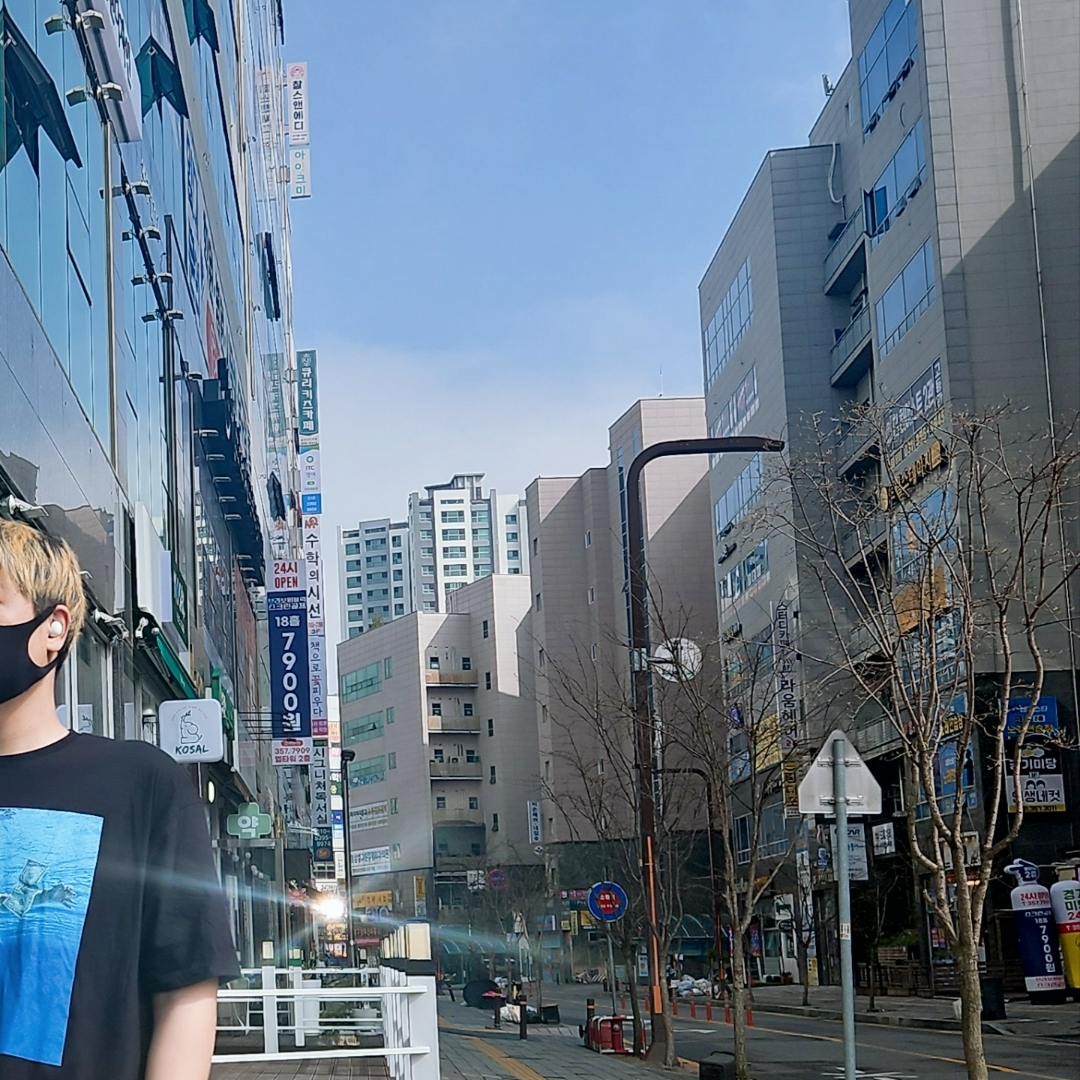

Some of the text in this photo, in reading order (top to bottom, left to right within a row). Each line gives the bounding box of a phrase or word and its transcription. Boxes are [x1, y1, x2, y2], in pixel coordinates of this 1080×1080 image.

[301, 367, 315, 431] 큐리키즈카페
[274, 561, 298, 575] 24시
[305, 533, 321, 619] 수학의시선
[274, 576, 298, 589] OPEN
[275, 615, 300, 628] 18홀
[175, 744, 209, 755] KOSAL
[313, 748, 328, 825] 시그니처독서실
[237, 815, 259, 838] 약
